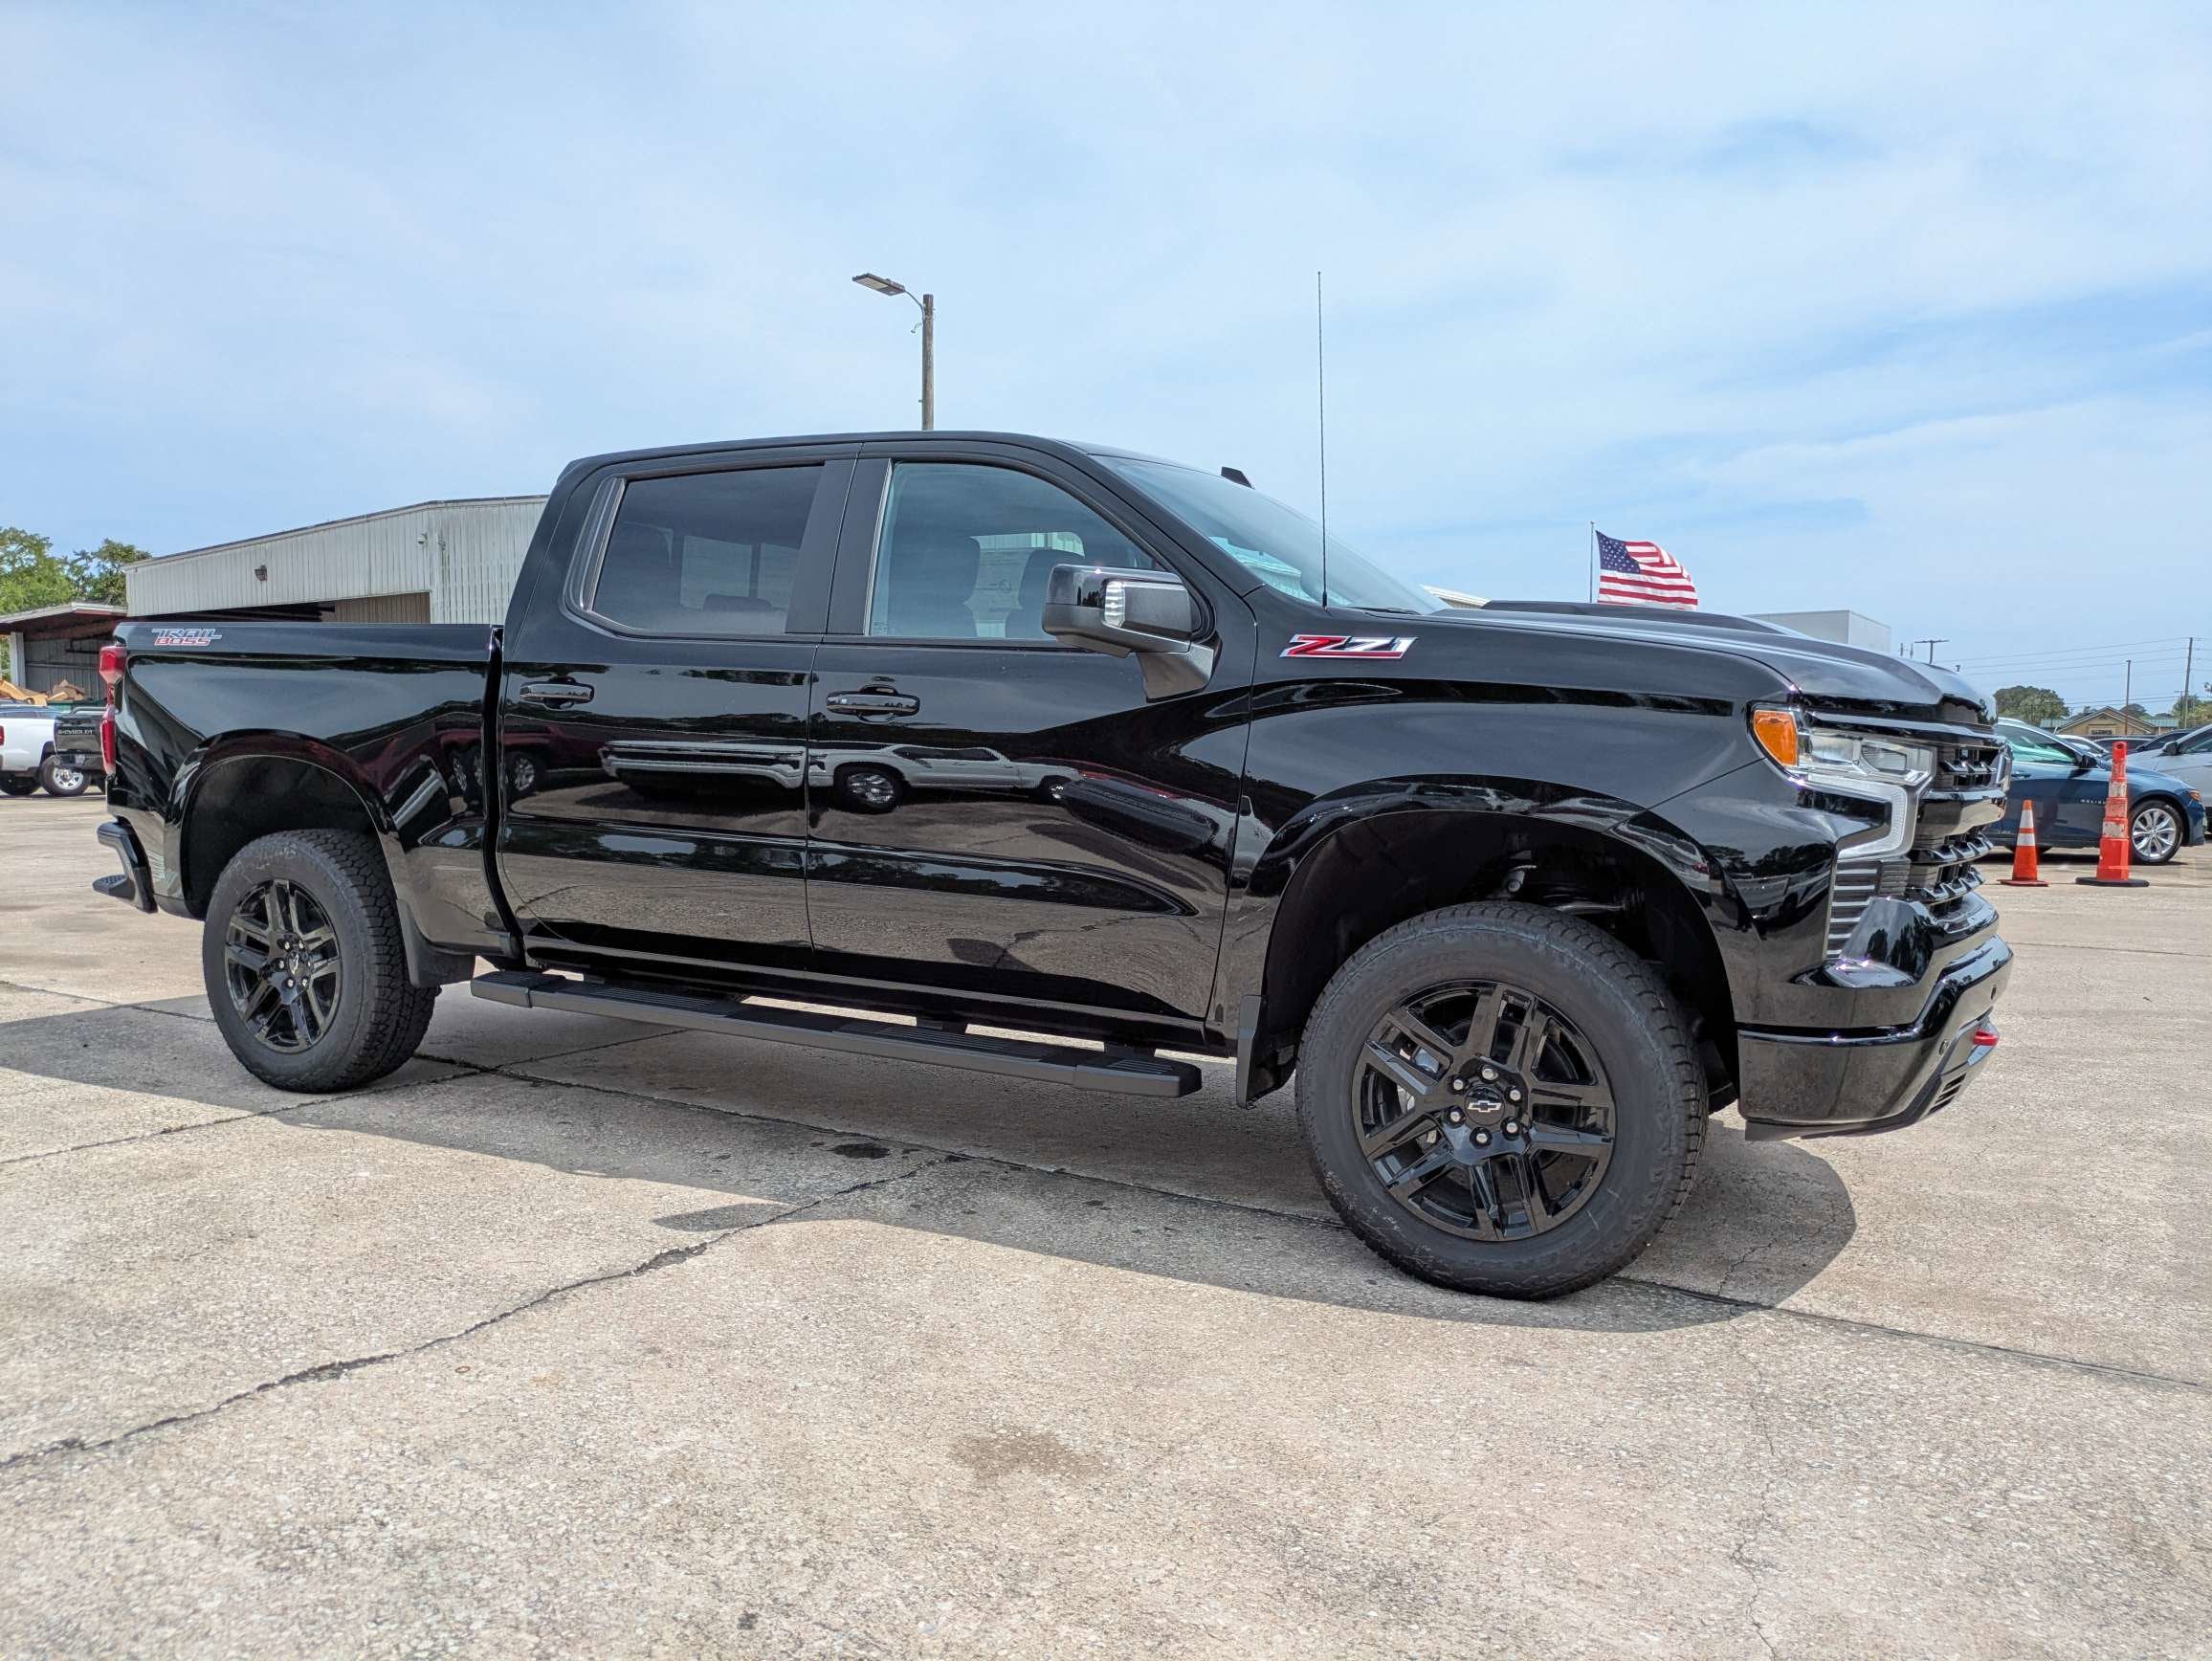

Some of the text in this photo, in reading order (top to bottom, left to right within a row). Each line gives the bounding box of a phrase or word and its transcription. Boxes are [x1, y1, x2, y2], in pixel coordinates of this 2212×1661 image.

[151, 629, 222, 639] TRAIL
[154, 637, 211, 646] BOSS
[1279, 634, 1419, 659] Z71
